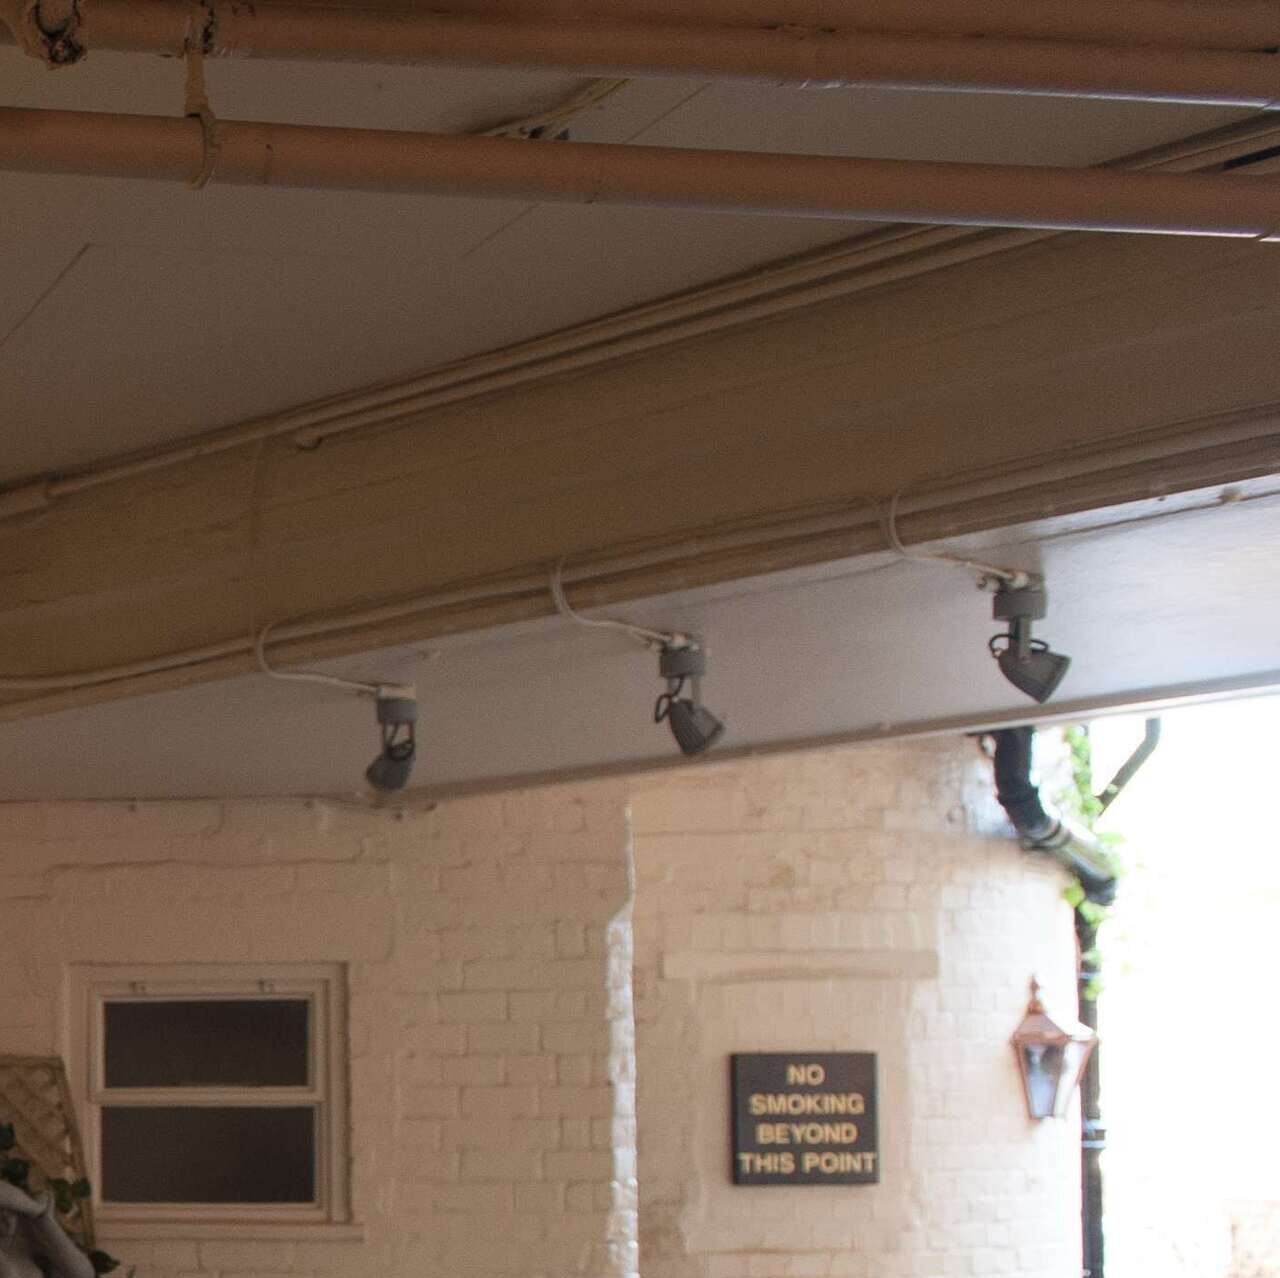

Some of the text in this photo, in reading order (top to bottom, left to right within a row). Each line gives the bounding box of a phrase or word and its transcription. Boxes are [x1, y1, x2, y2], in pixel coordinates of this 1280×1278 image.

[787, 1062, 826, 1086] NO
[749, 1092, 866, 1116] SMOKING
[756, 1121, 859, 1145] BEYOND
[739, 1150, 878, 1174] THIS POINT
